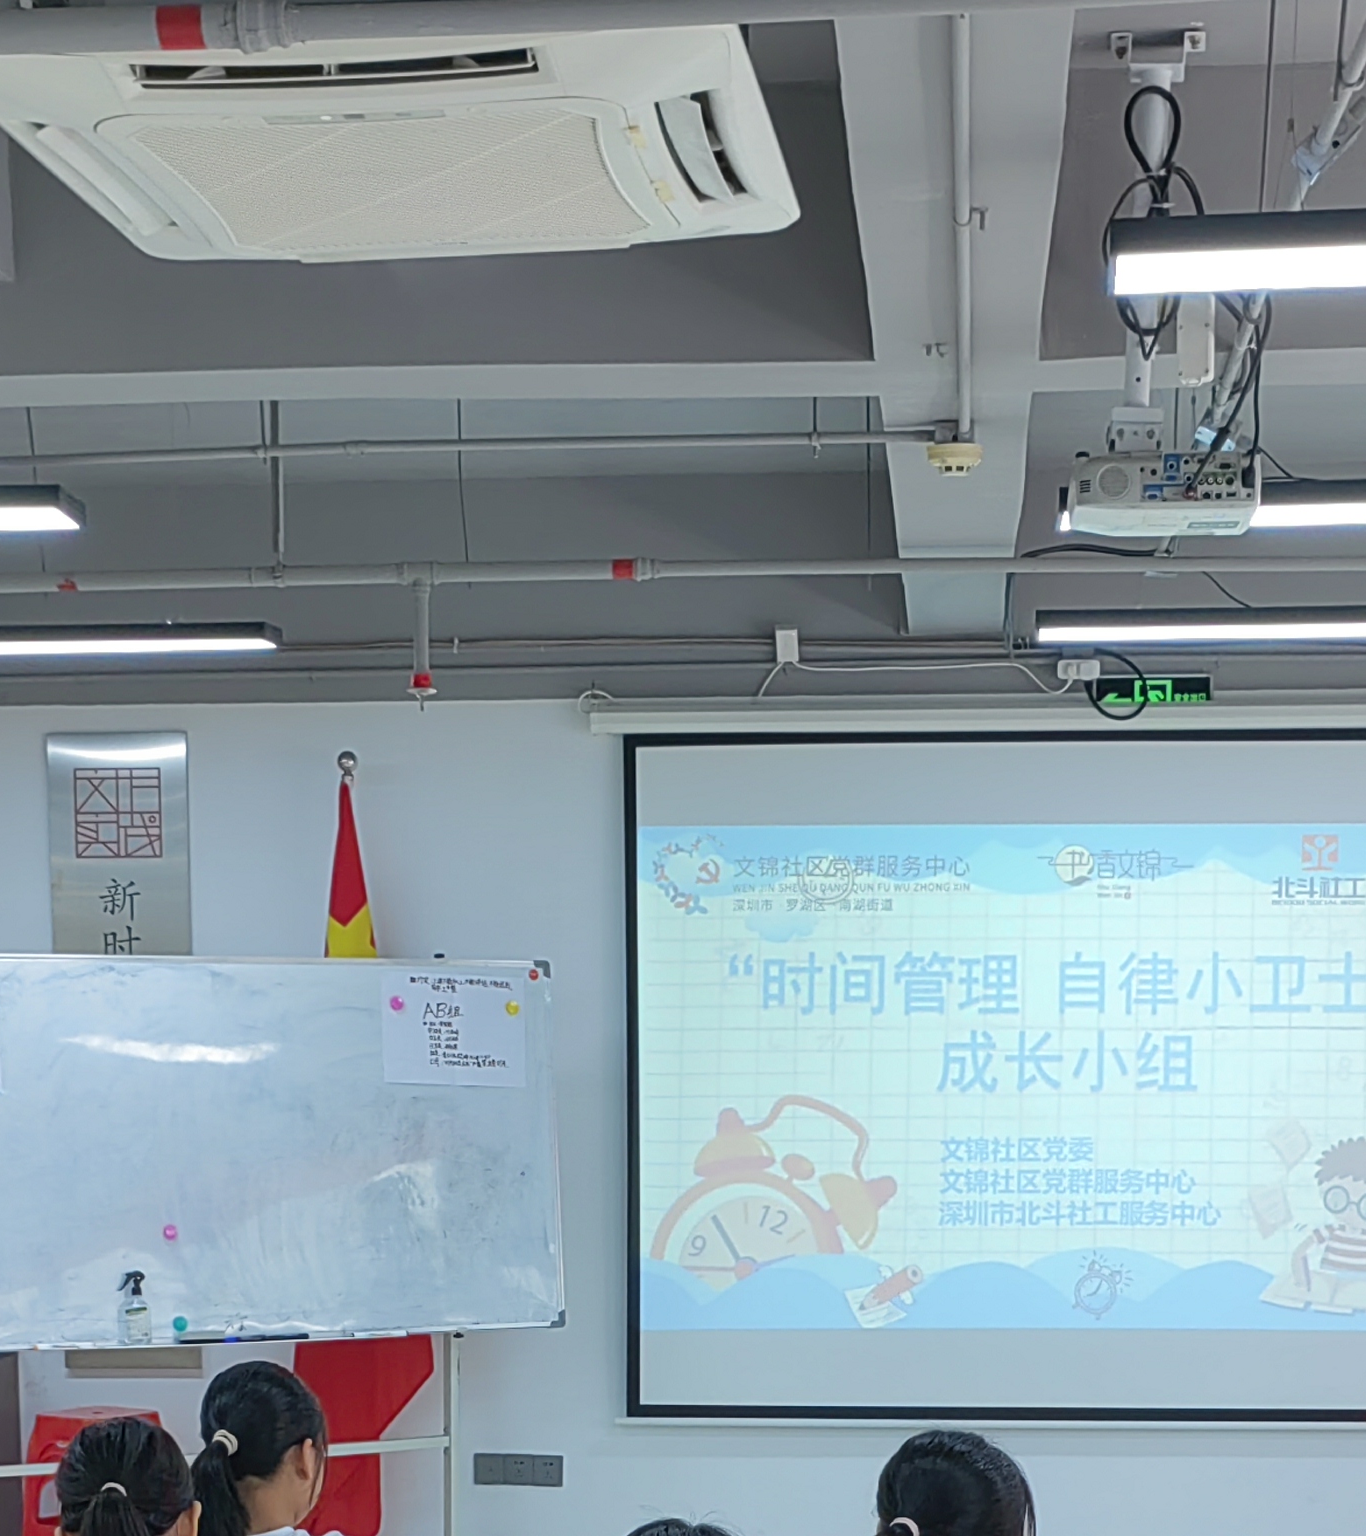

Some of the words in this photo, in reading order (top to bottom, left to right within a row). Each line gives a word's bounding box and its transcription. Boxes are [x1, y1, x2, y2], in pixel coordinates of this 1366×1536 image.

[733, 855, 970, 878] 文锦社区党群服务中心
[778, 883, 798, 893] SHE
[852, 883, 874, 893] QUN
[877, 883, 891, 893] FU
[894, 883, 910, 893] WU
[913, 883, 950, 893] ZHONG
[1272, 876, 1366, 898] 北斗社工
[733, 899, 773, 912] 深圳市
[936, 1028, 1198, 1093] 成长小组
[940, 1137, 1094, 1163] 文锦社区党委
[939, 1168, 1197, 1195] 文锦社区党群服务中心
[760, 1205, 788, 1235] 12
[938, 1200, 1222, 1227] 深圳市北斗社工服务中心
[688, 1235, 706, 1256] 9
